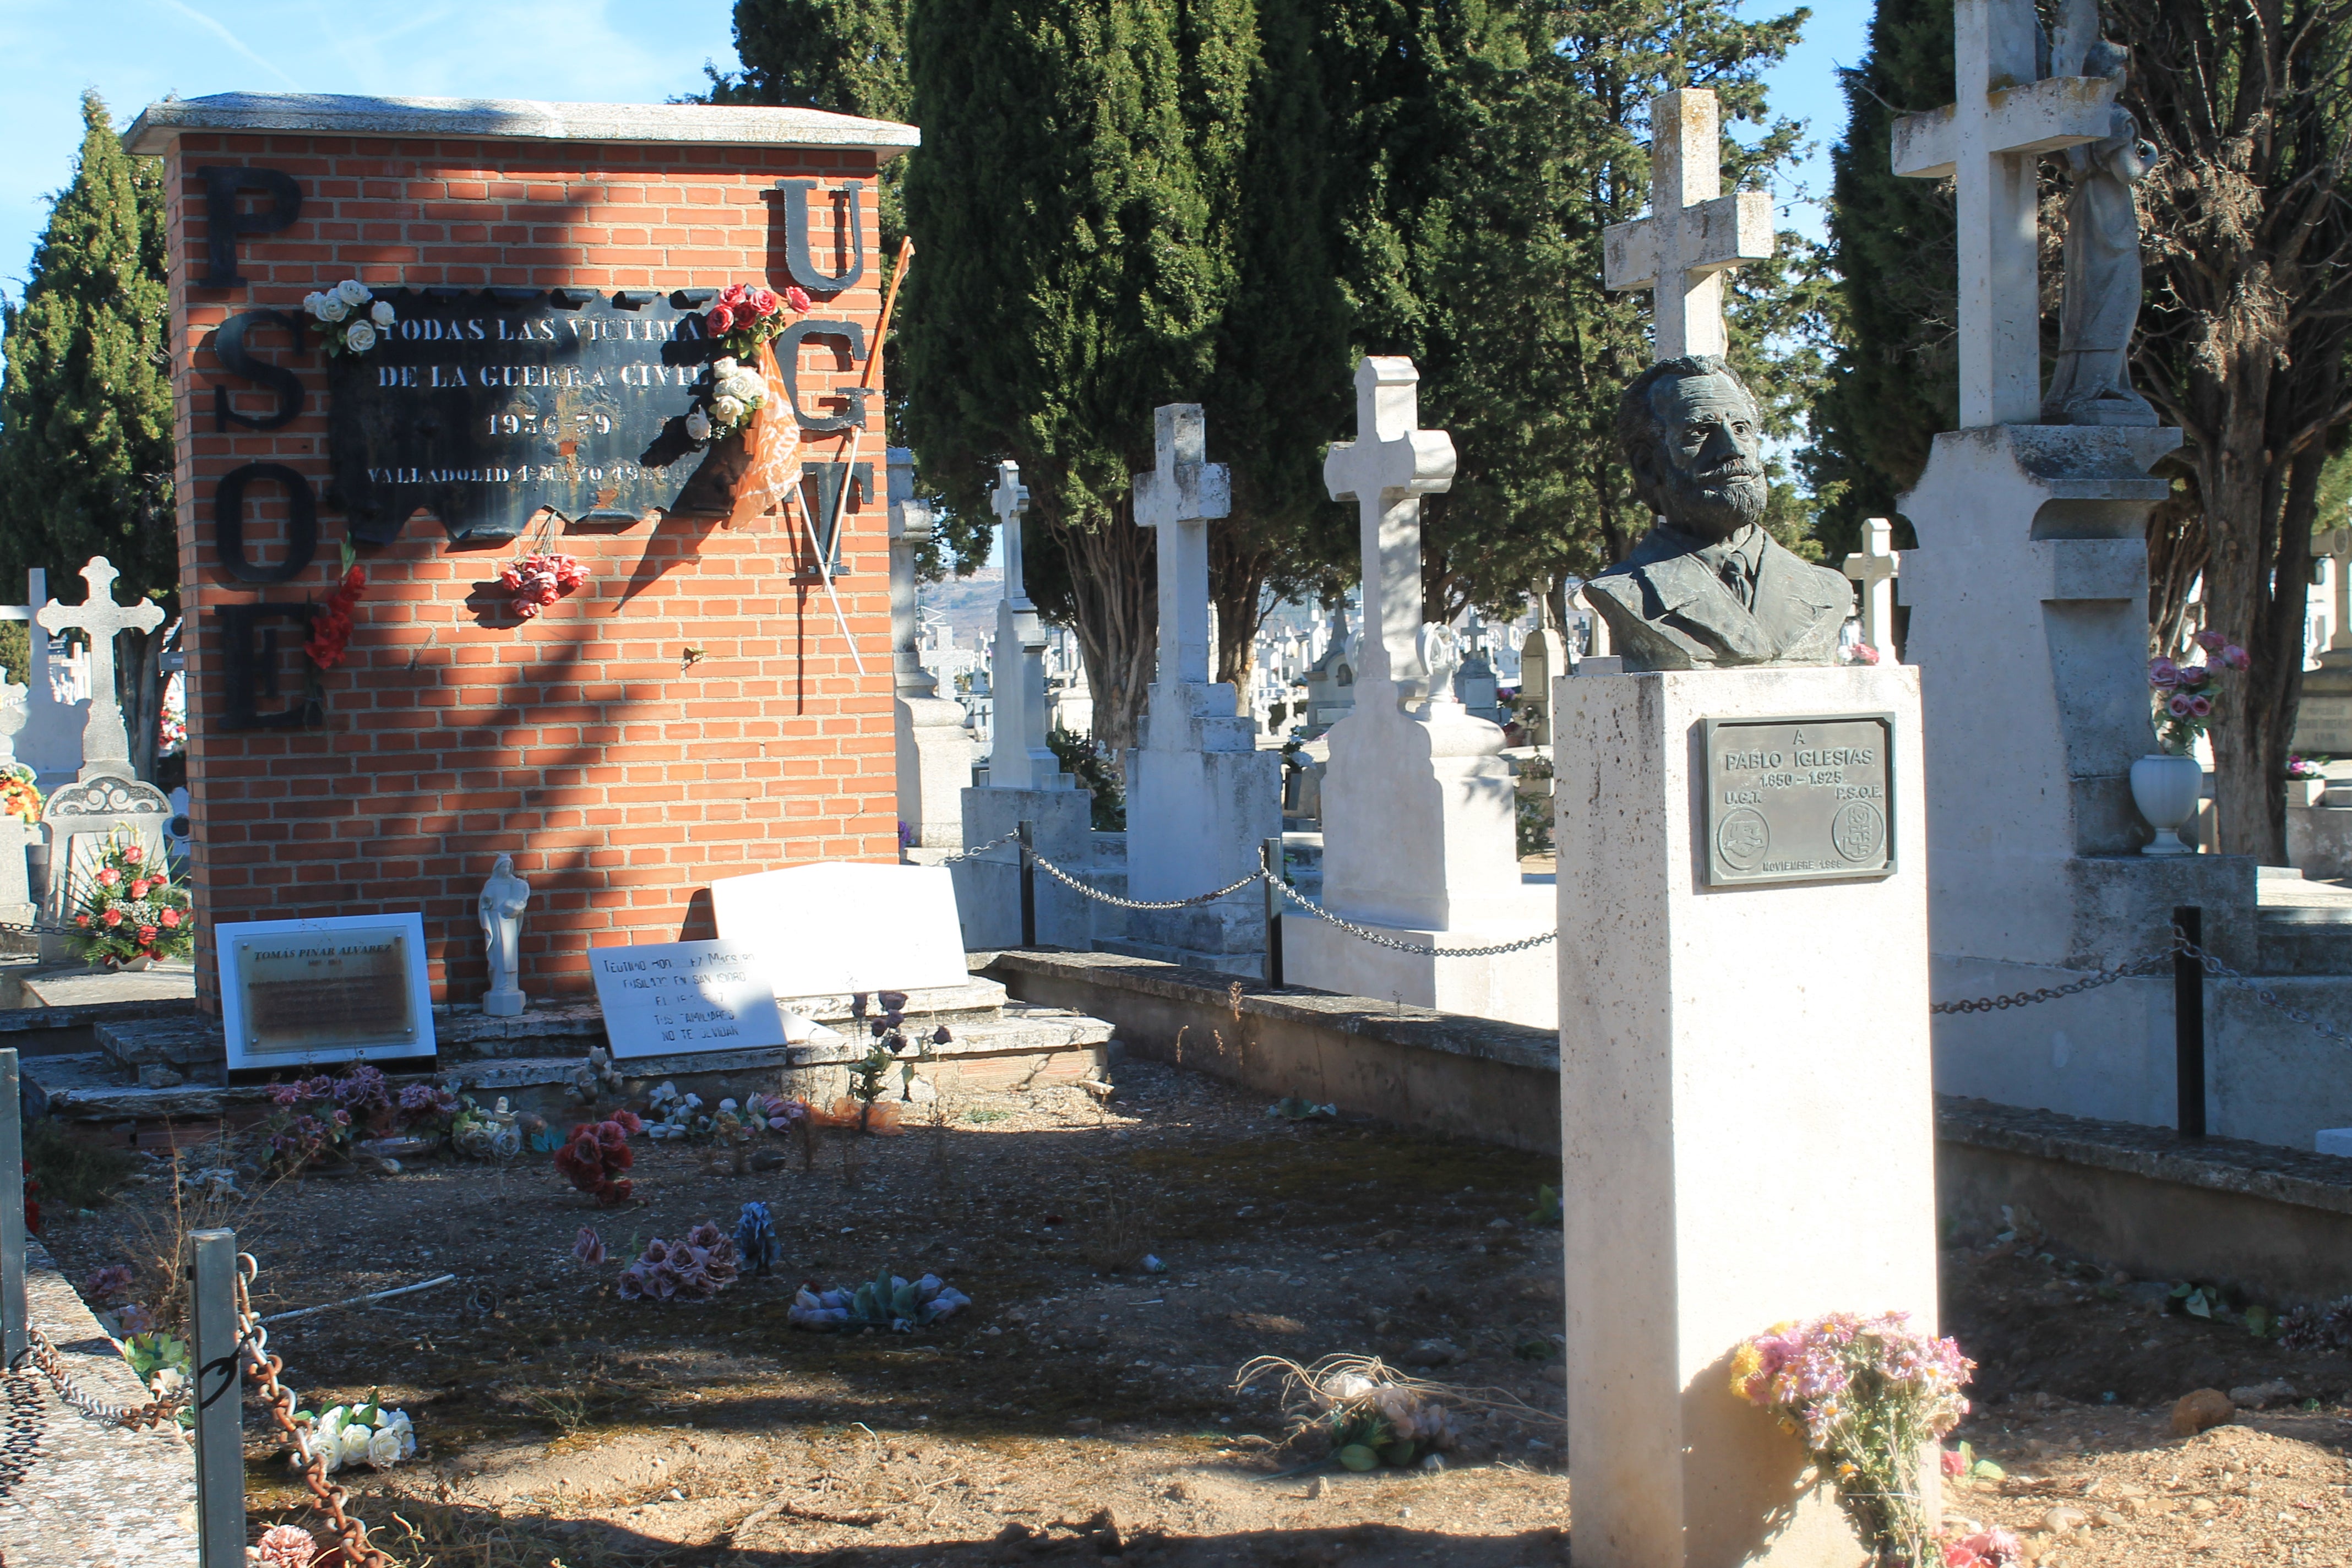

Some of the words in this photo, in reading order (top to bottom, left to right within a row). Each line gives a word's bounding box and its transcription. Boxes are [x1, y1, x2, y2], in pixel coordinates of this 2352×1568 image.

[497, 317, 556, 340] LAS
[378, 366, 418, 387] DE
[431, 366, 467, 387] LA
[480, 366, 610, 387] GUERRA
[620, 364, 709, 387] CIVIL
[367, 467, 511, 483] VALLADOLID
[1793, 729, 1806, 745] A
[1725, 750, 1782, 771] PABLO
[1794, 749, 1873, 767] IGLESIAS
[1762, 860, 1815, 872] NOVIEMBRE
[255, 948, 296, 961] TOMÁS
[692, 973, 712, 984] SAN
[680, 1010, 735, 1022] AMILIARES
[662, 1030, 676, 1041] NO
[680, 1028, 694, 1039] TE
